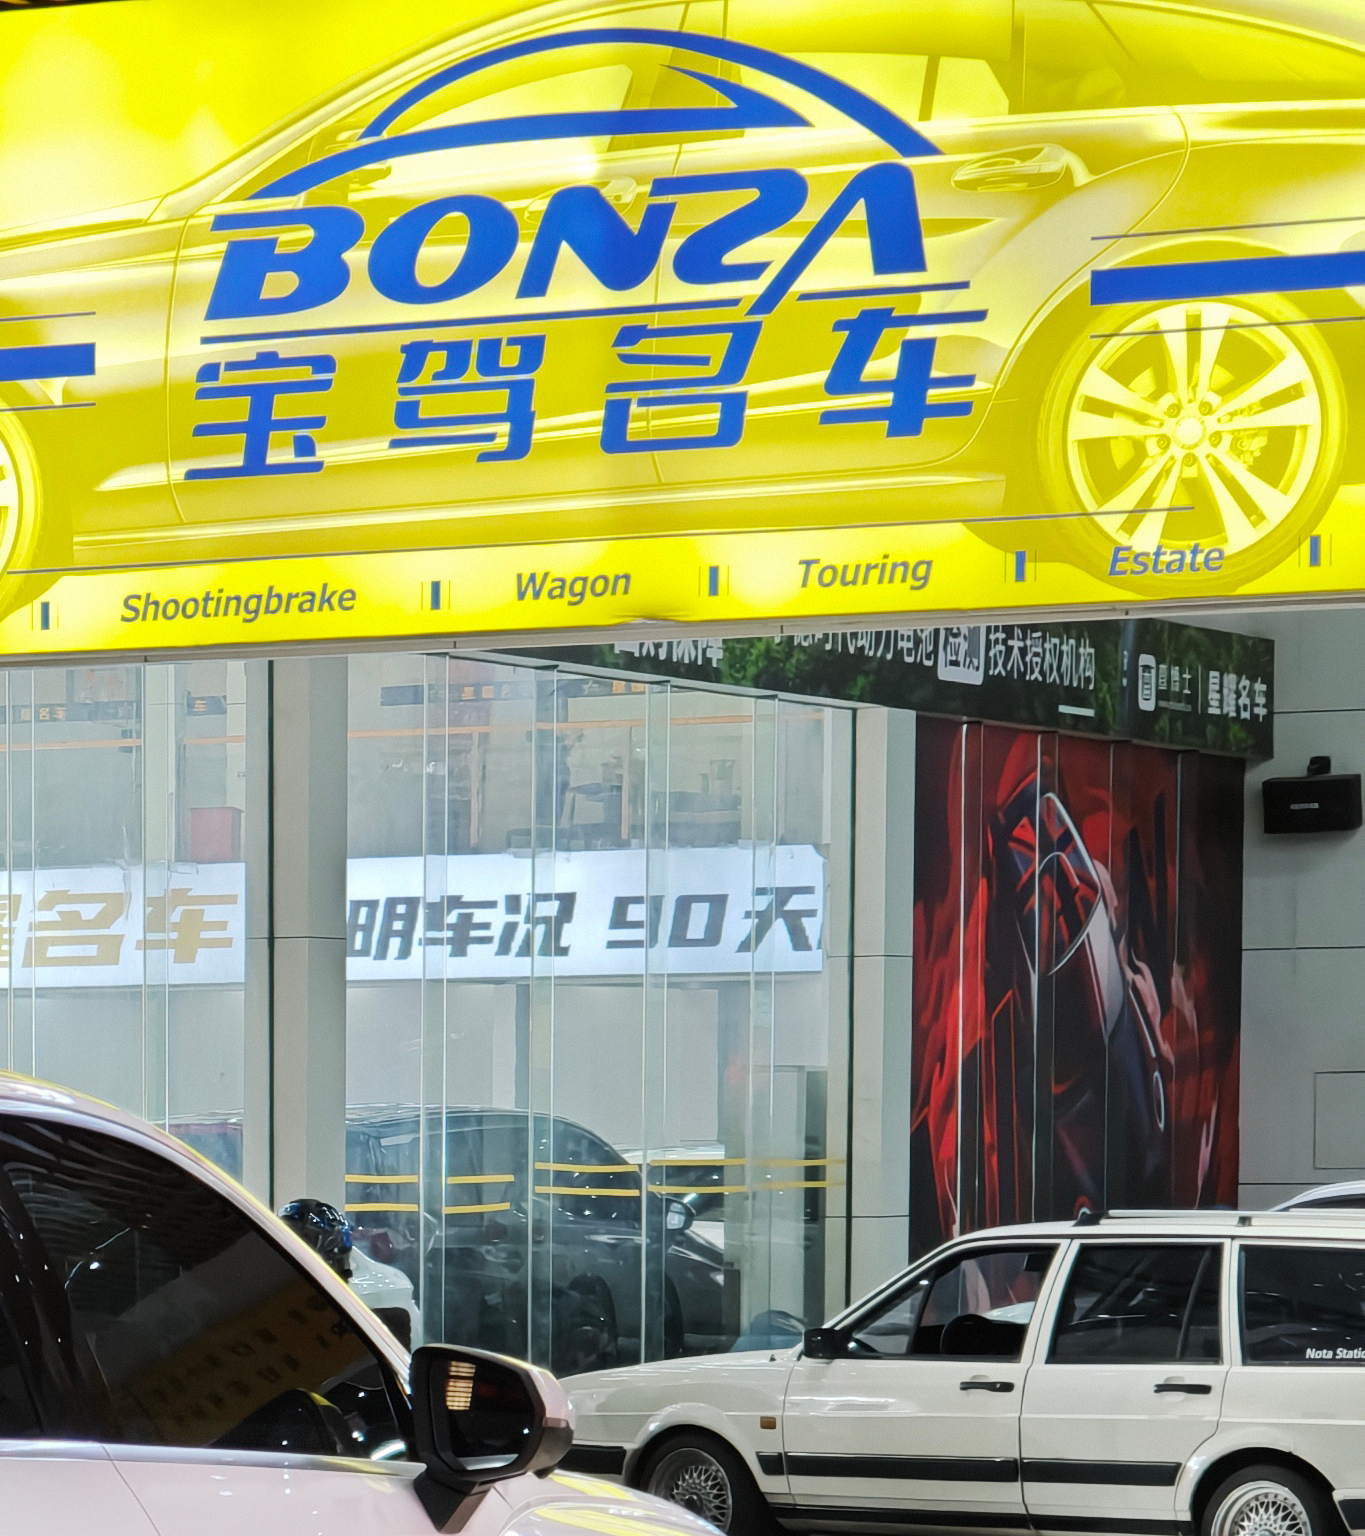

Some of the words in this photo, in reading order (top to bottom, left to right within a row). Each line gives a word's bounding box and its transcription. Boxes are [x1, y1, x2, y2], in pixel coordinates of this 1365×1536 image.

[184, 307, 989, 480] 宝驾名车
[119, 582, 357, 624] Shootingbrake
[515, 571, 632, 607] Wagon
[798, 553, 934, 591] Touring
[1107, 543, 1226, 577] Estate
[606, 885, 822, 955] 90天
[1305, 1347, 1334, 1359] Nota
